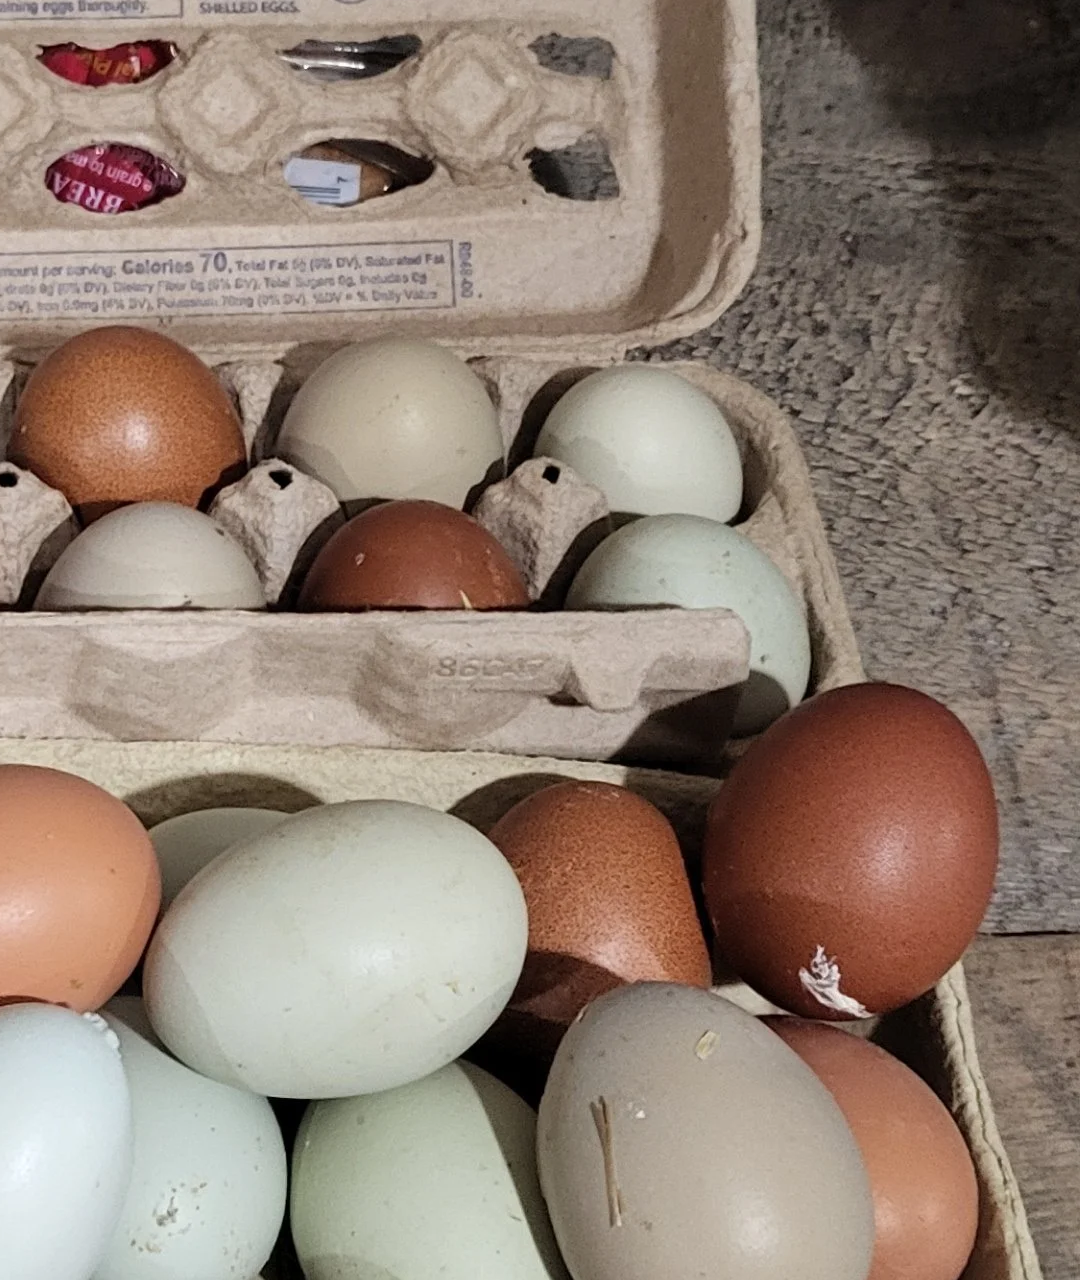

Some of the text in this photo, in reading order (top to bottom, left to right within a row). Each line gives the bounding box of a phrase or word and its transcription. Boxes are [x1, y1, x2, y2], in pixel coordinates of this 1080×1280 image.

[199, 1, 259, 14] SHELLED
[106, 164, 145, 188] grain
[121, 258, 195, 276] Calories
